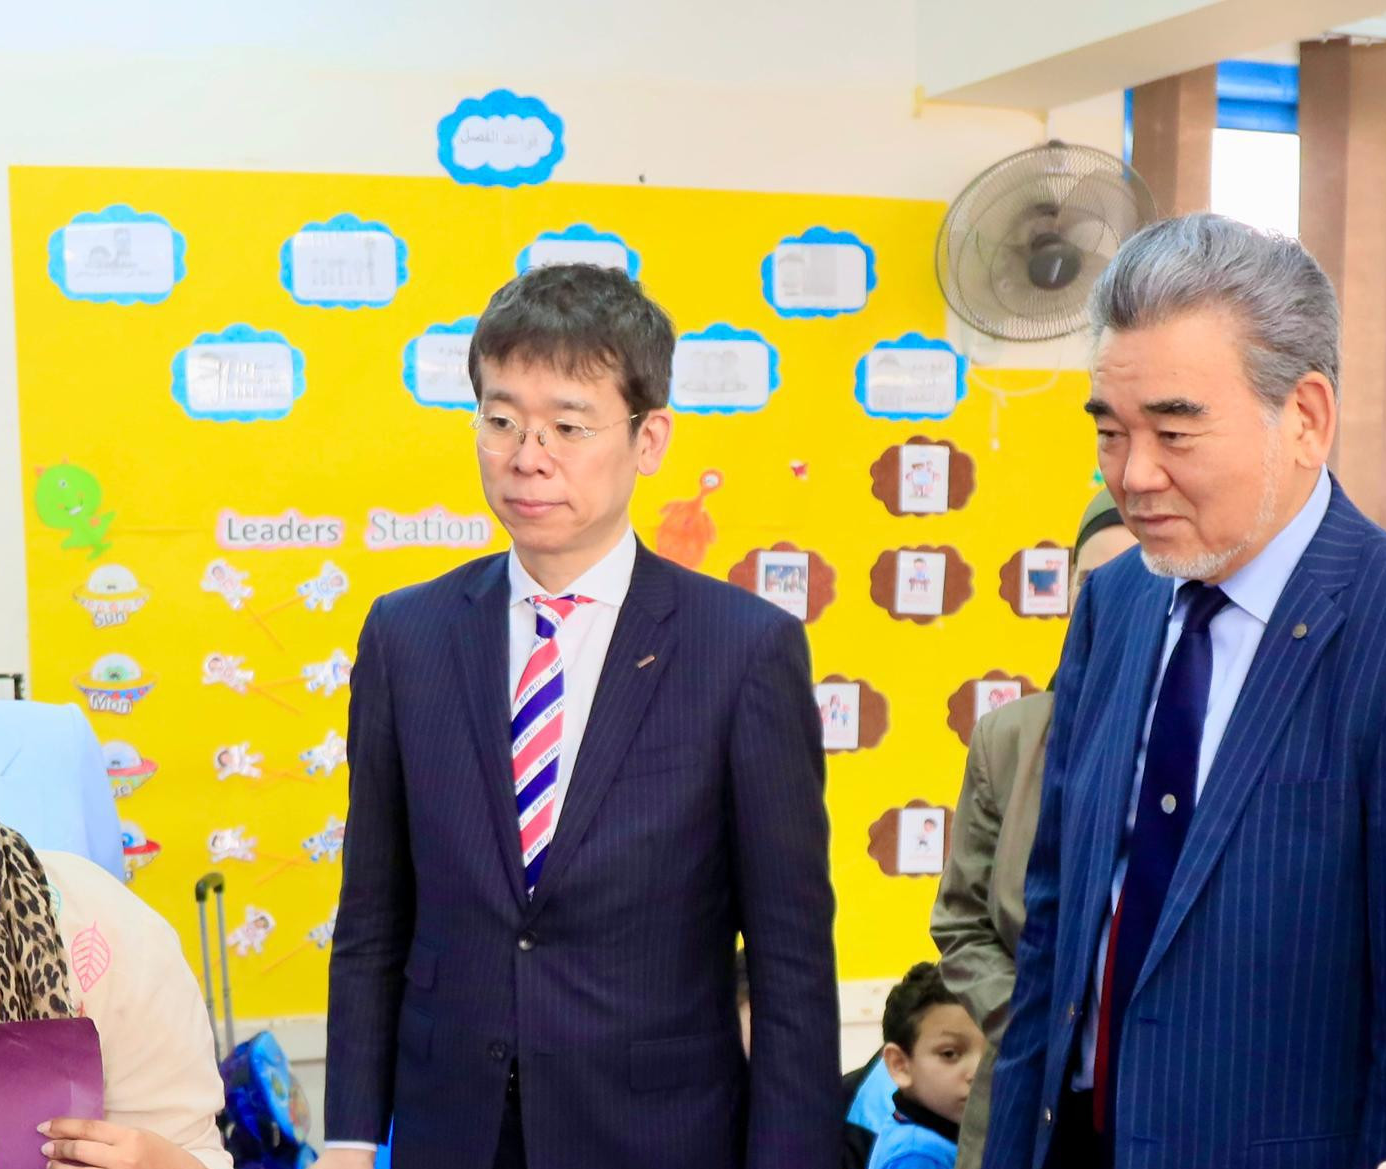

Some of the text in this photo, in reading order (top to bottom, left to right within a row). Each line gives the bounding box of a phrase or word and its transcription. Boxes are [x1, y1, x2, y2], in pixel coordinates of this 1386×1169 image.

[227, 511, 487, 542] Leaders Station
[91, 693, 131, 713] Mon
